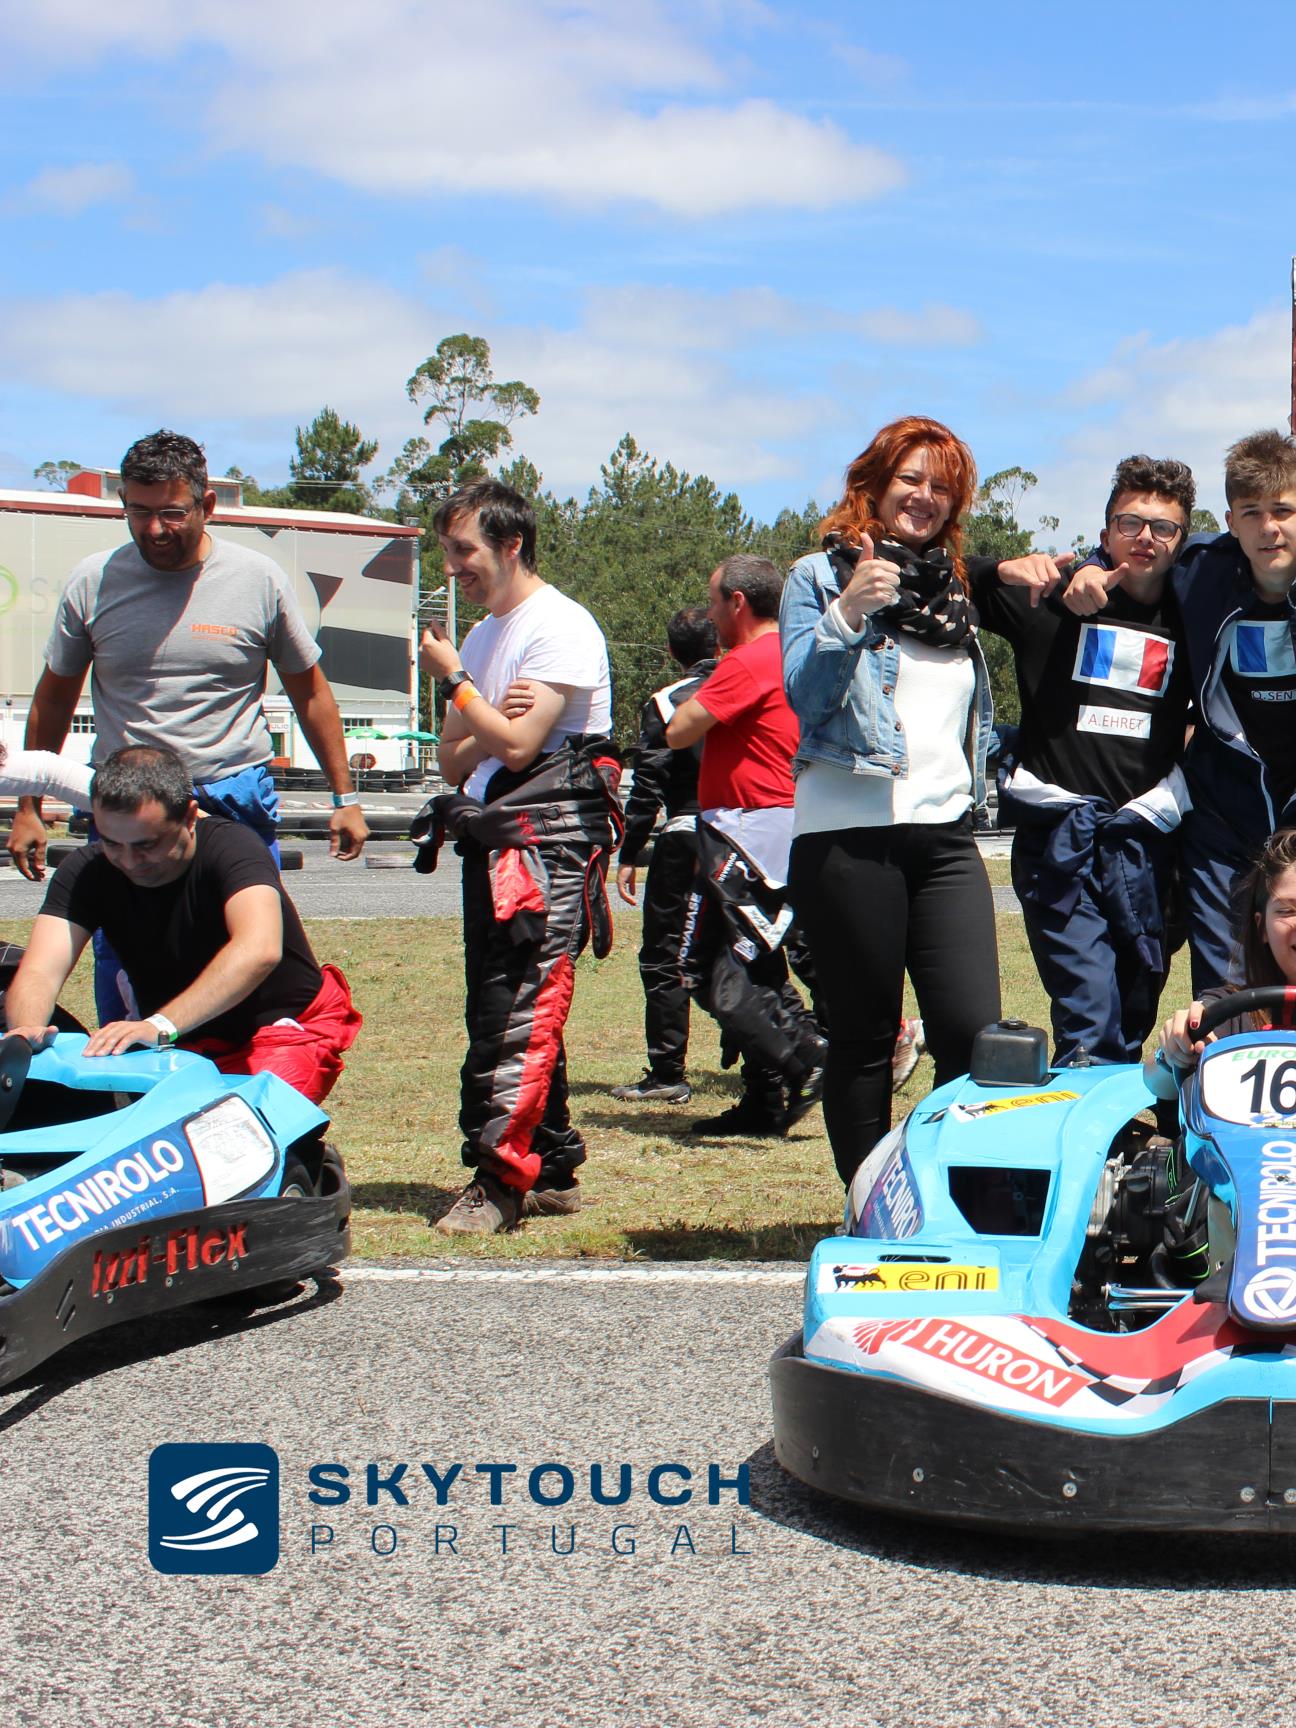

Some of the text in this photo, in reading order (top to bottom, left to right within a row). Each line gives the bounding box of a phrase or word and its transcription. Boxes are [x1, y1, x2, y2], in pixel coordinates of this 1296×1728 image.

[1087, 713, 1145, 731] A.EHRET
[12, 1138, 184, 1252] TECNIROLO
[899, 1265, 986, 1291] eni
[922, 1323, 1073, 1400] HURON
